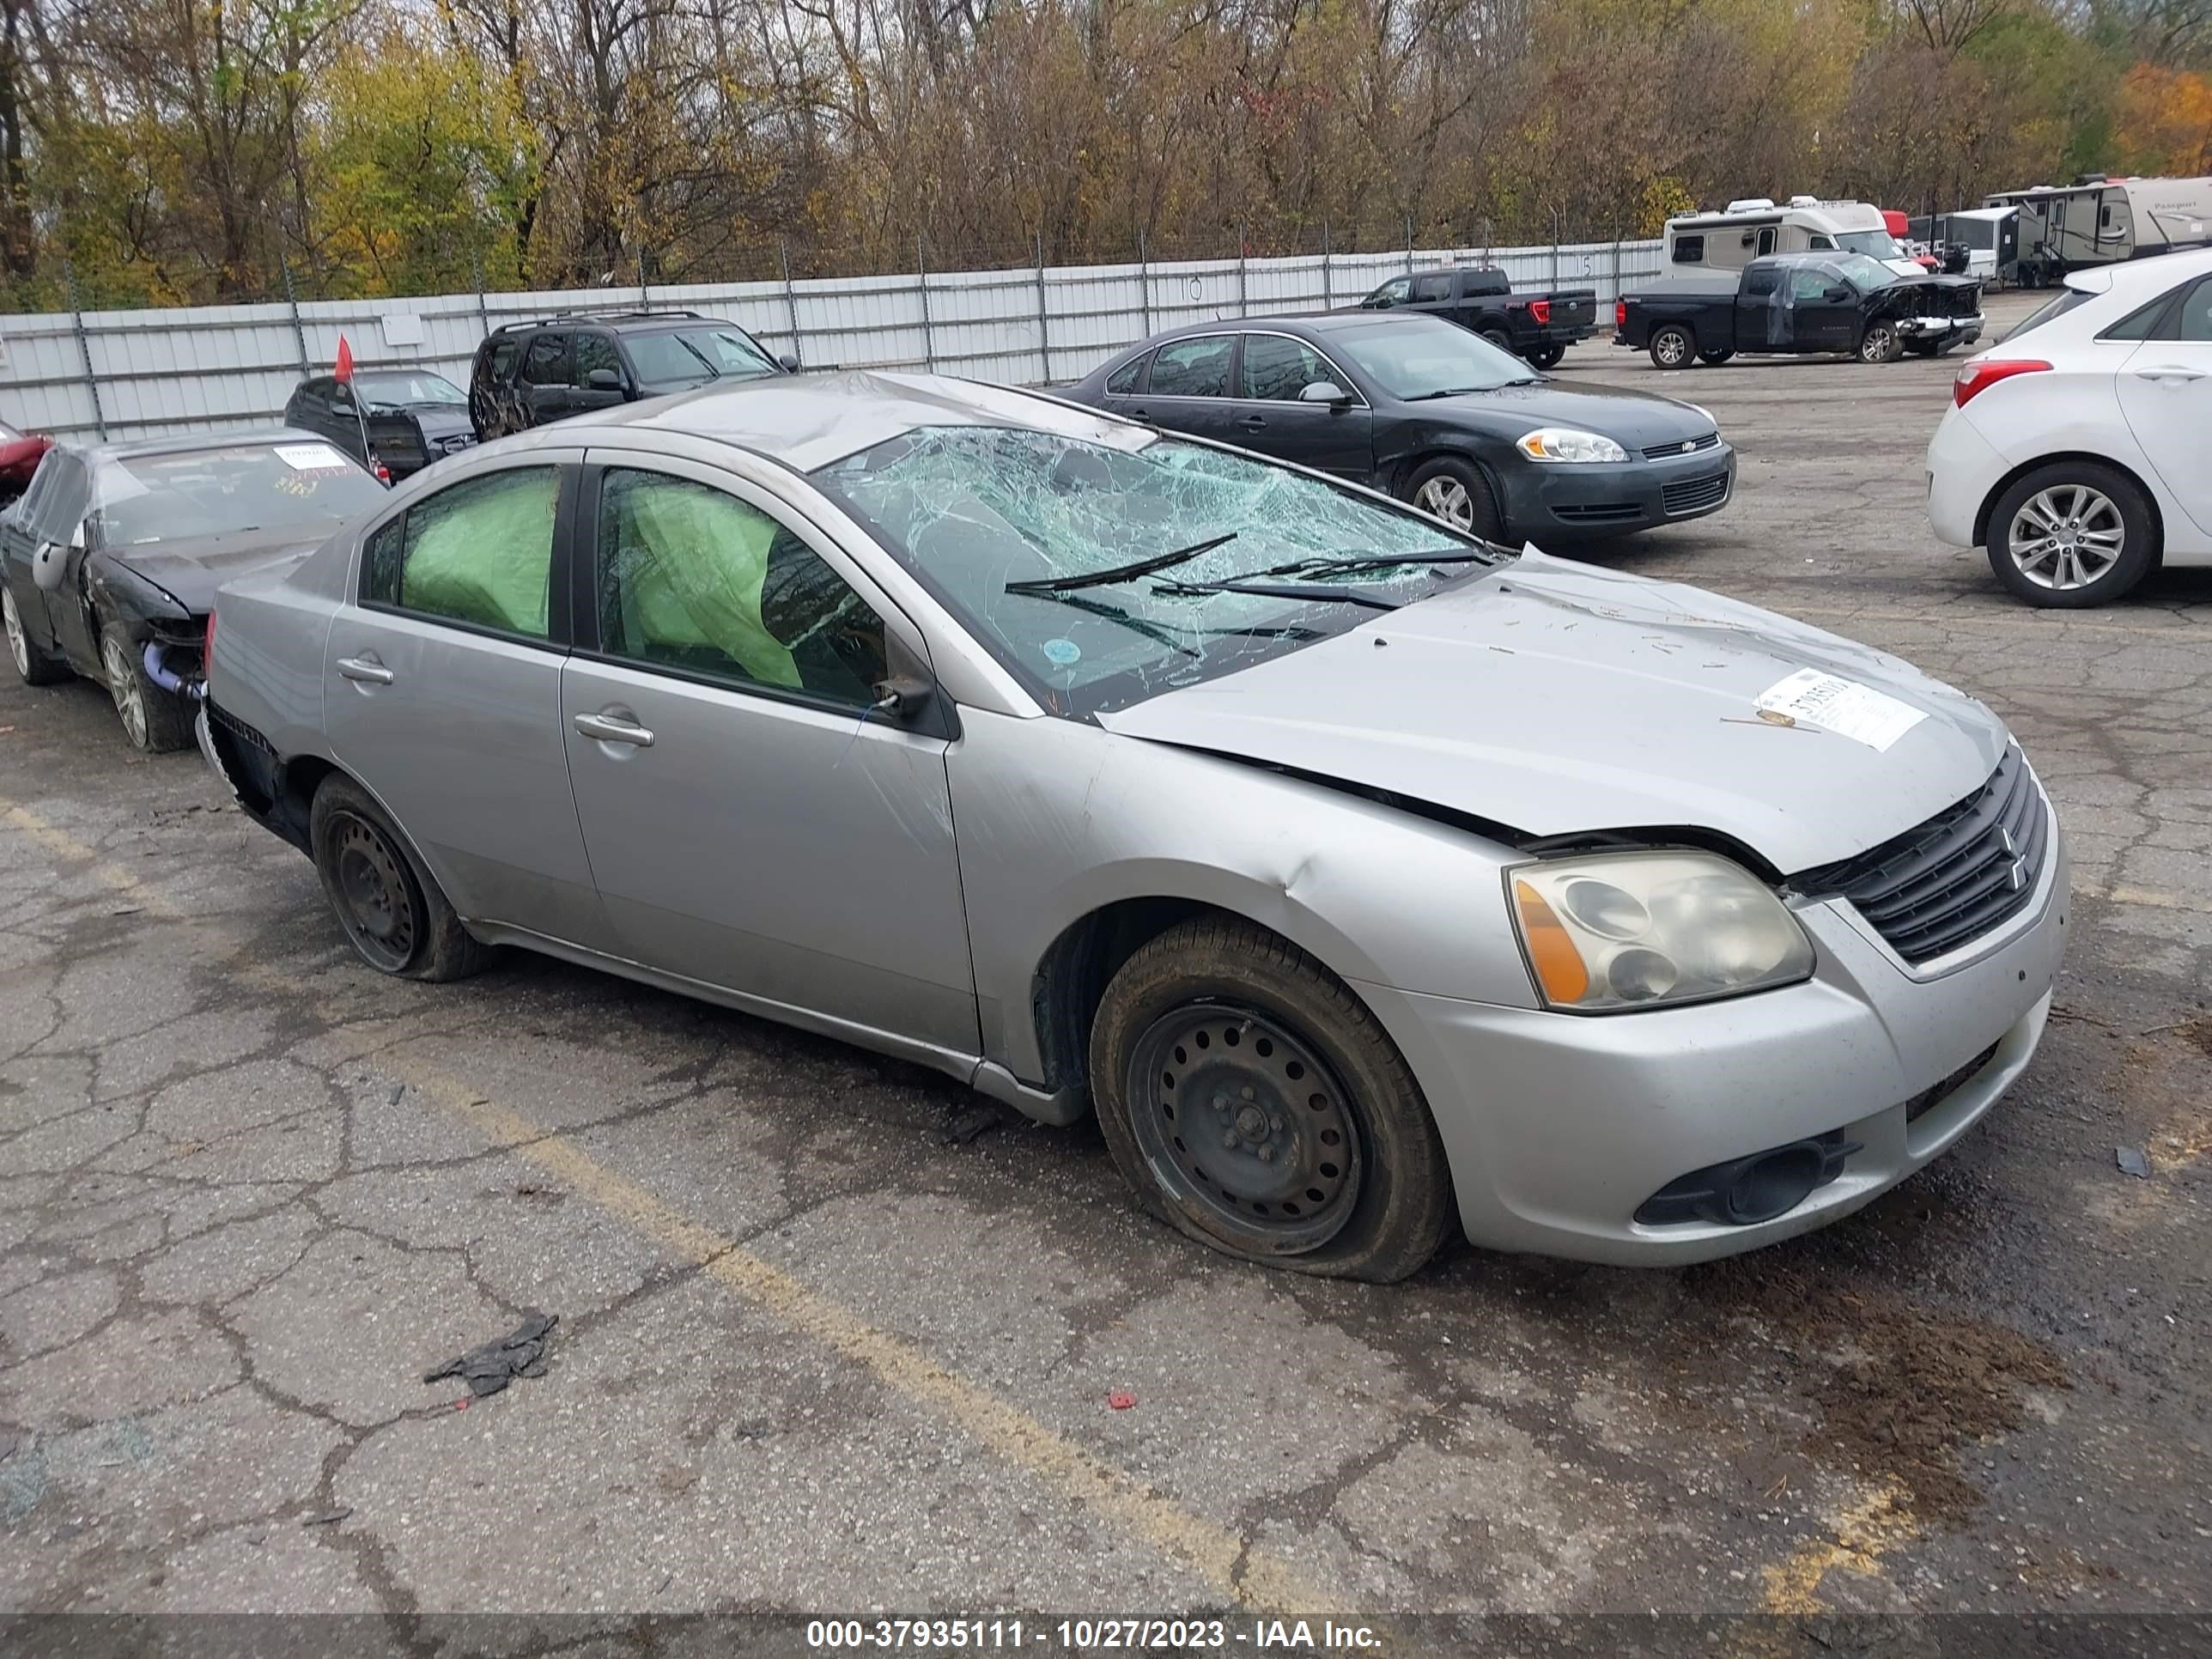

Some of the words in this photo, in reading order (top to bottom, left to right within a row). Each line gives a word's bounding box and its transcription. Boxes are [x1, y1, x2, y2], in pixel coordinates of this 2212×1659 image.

[2154, 201, 2197, 210] Passport
[1576, 256, 1591, 276] 15
[1181, 276, 1202, 301] 10
